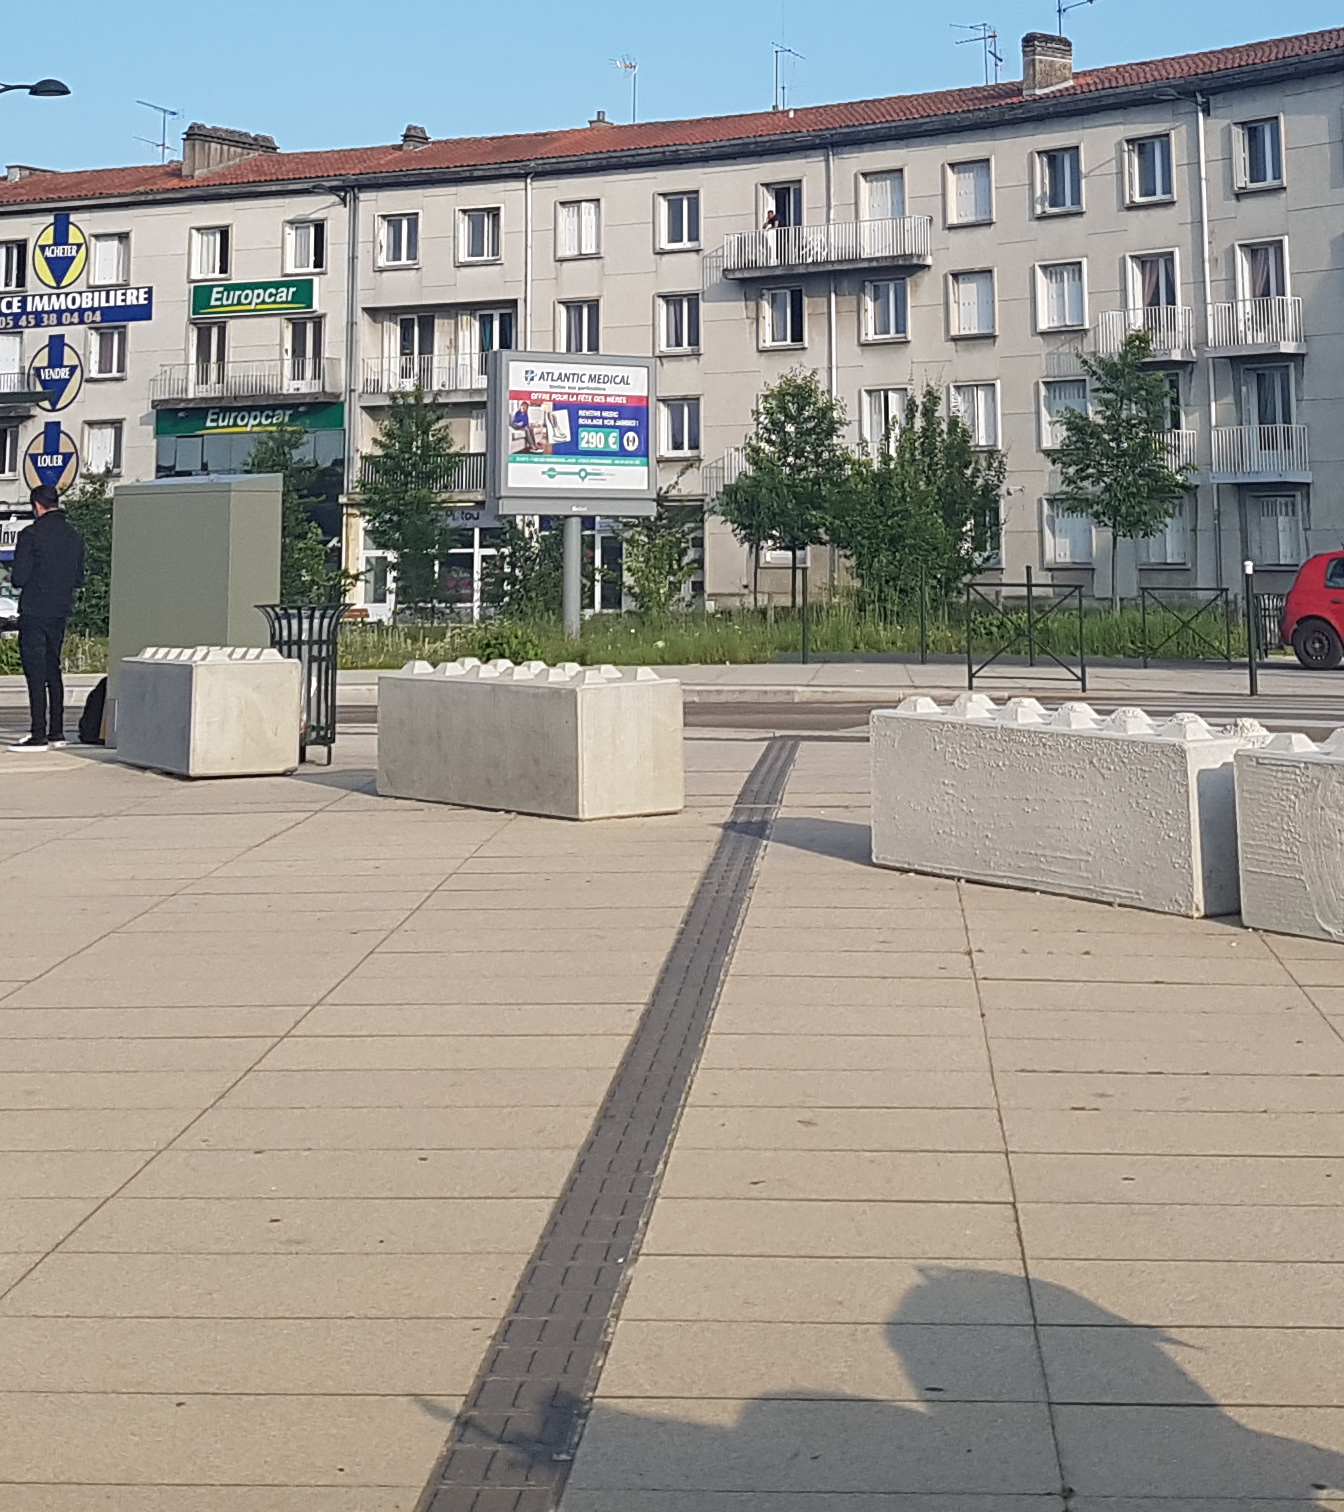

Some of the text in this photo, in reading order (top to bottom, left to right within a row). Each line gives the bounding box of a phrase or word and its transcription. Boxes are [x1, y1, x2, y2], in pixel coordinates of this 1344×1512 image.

[44, 245, 78, 258] ACHETER
[26, 288, 149, 313] IMMOBILIERE
[210, 287, 297, 309] Europcar
[19, 314, 36, 327] 45
[41, 313, 57, 326] 38
[62, 312, 79, 325] 04
[84, 310, 102, 323] 04
[40, 367, 70, 380] VENDRE
[538, 371, 631, 386] ATLANTIC MEDICAL
[552, 393, 568, 401] POUR
[569, 394, 577, 402] LA
[206, 408, 293, 431] Europcar
[580, 432, 618, 448] 290 €
[37, 455, 63, 467] LOUER
